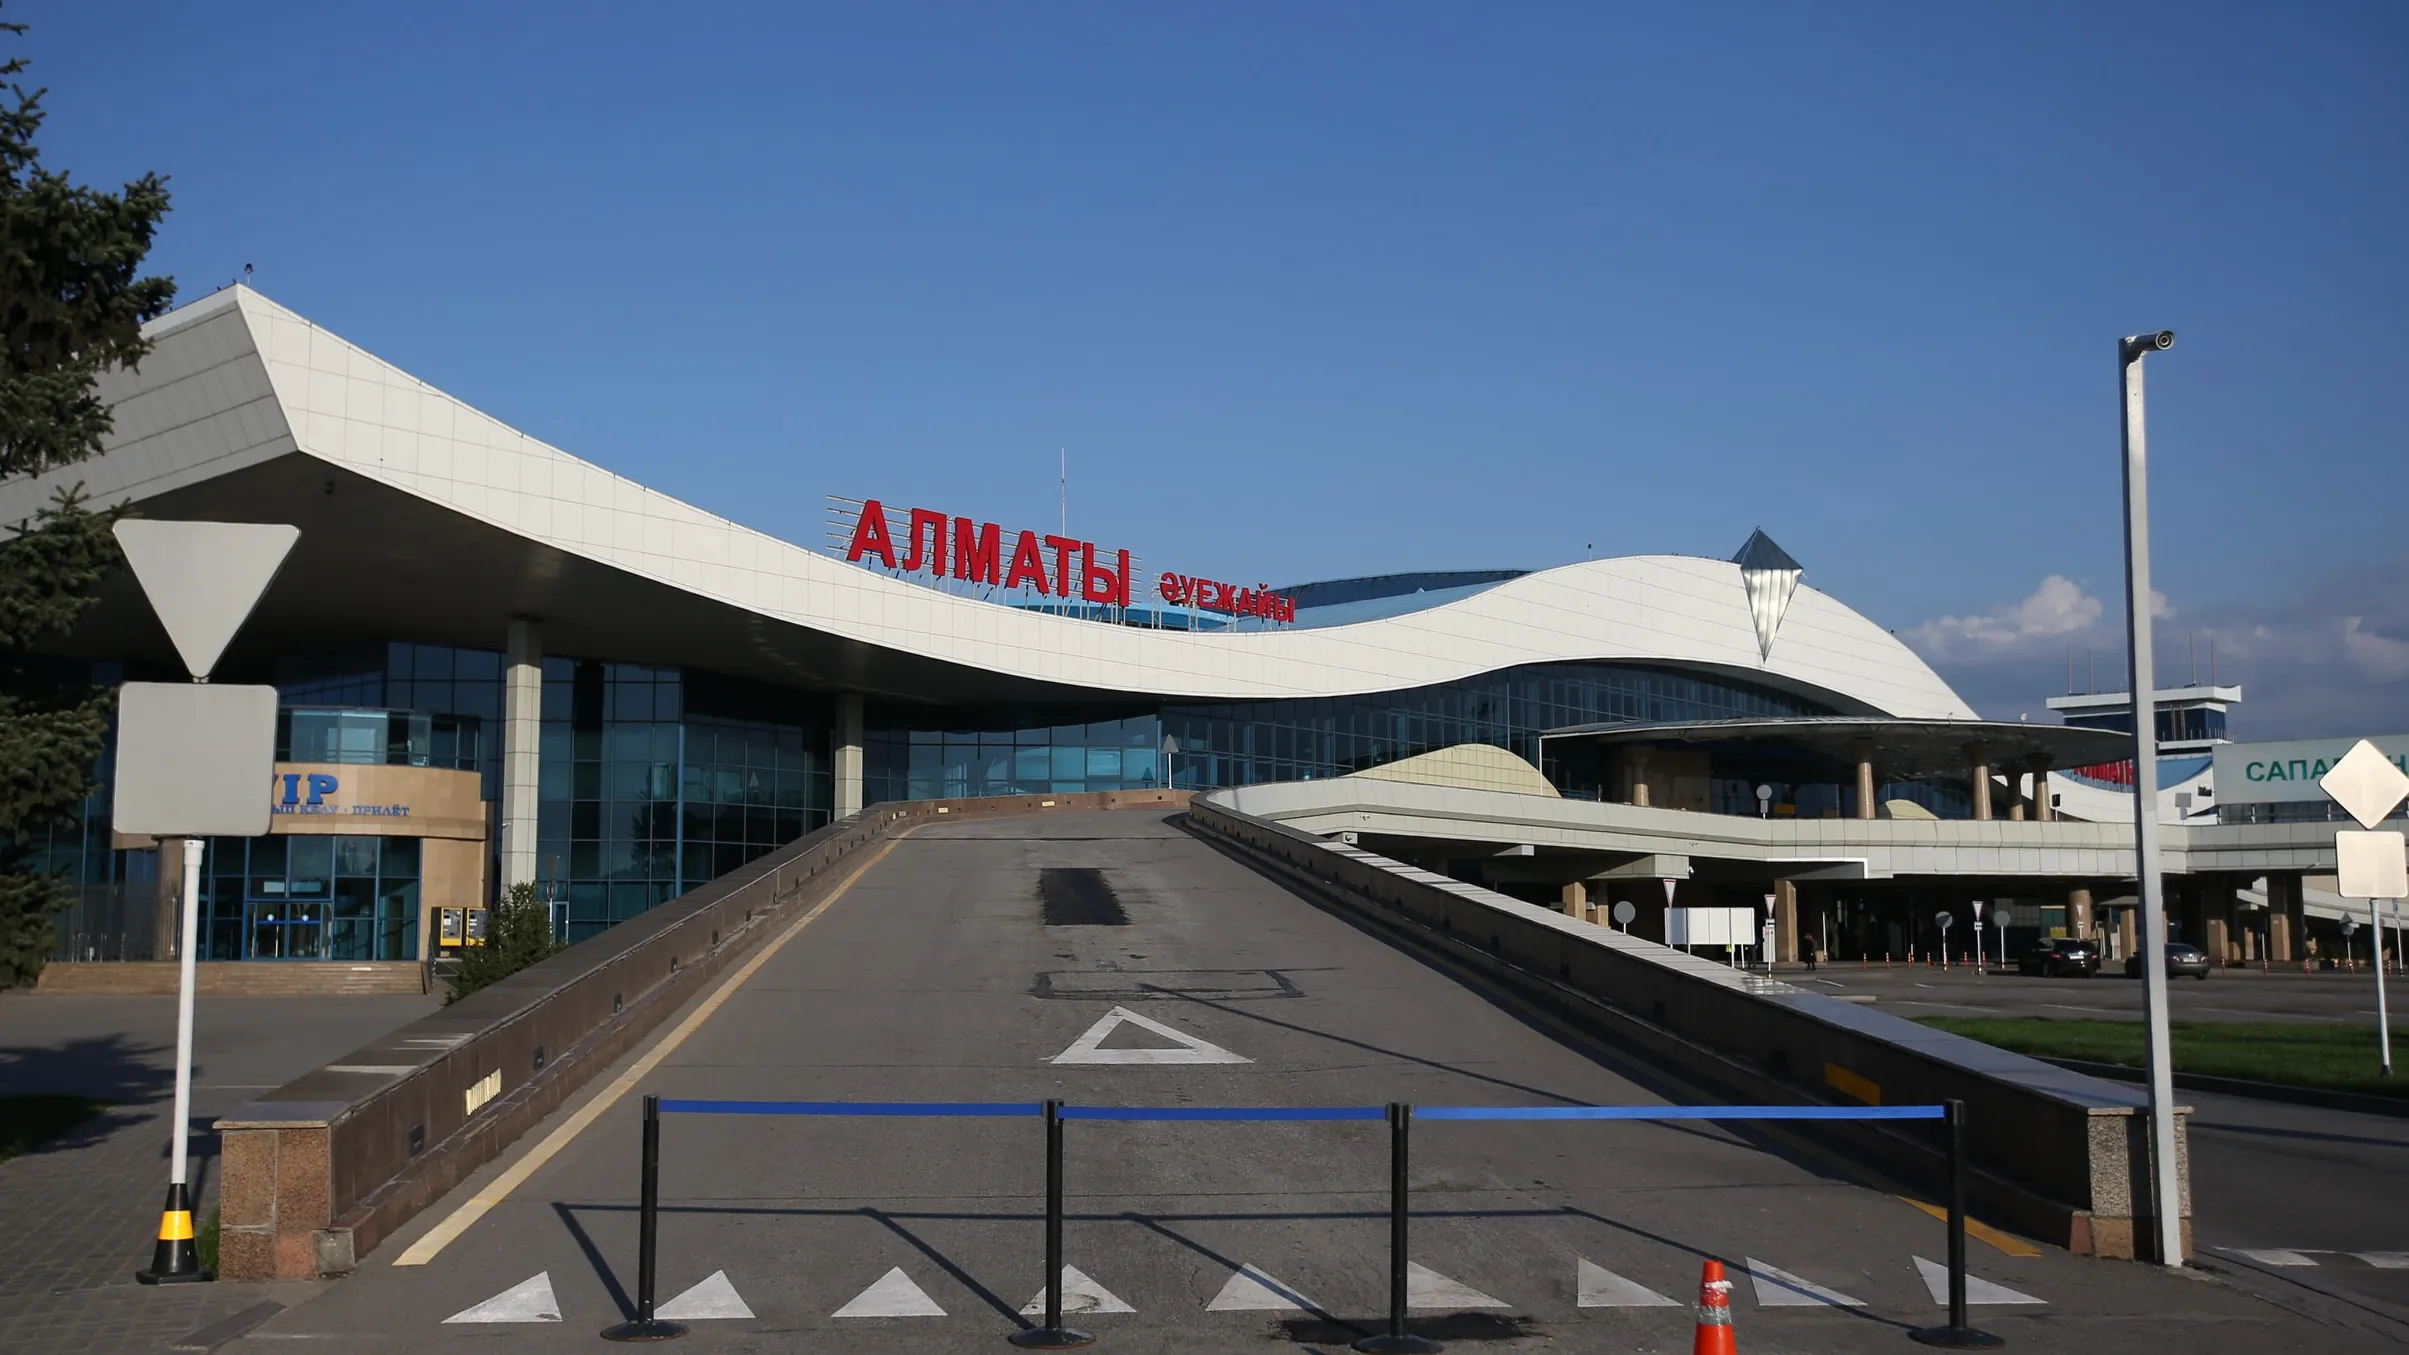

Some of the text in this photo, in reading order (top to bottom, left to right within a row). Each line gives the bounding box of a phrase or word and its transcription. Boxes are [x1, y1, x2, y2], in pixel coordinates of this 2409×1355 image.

[846, 499, 1297, 623] АЛМАТЫ ӘУЕЖАЙЫ
[272, 773, 339, 805] IP
[352, 804, 410, 817] ПРИЛЁТ
